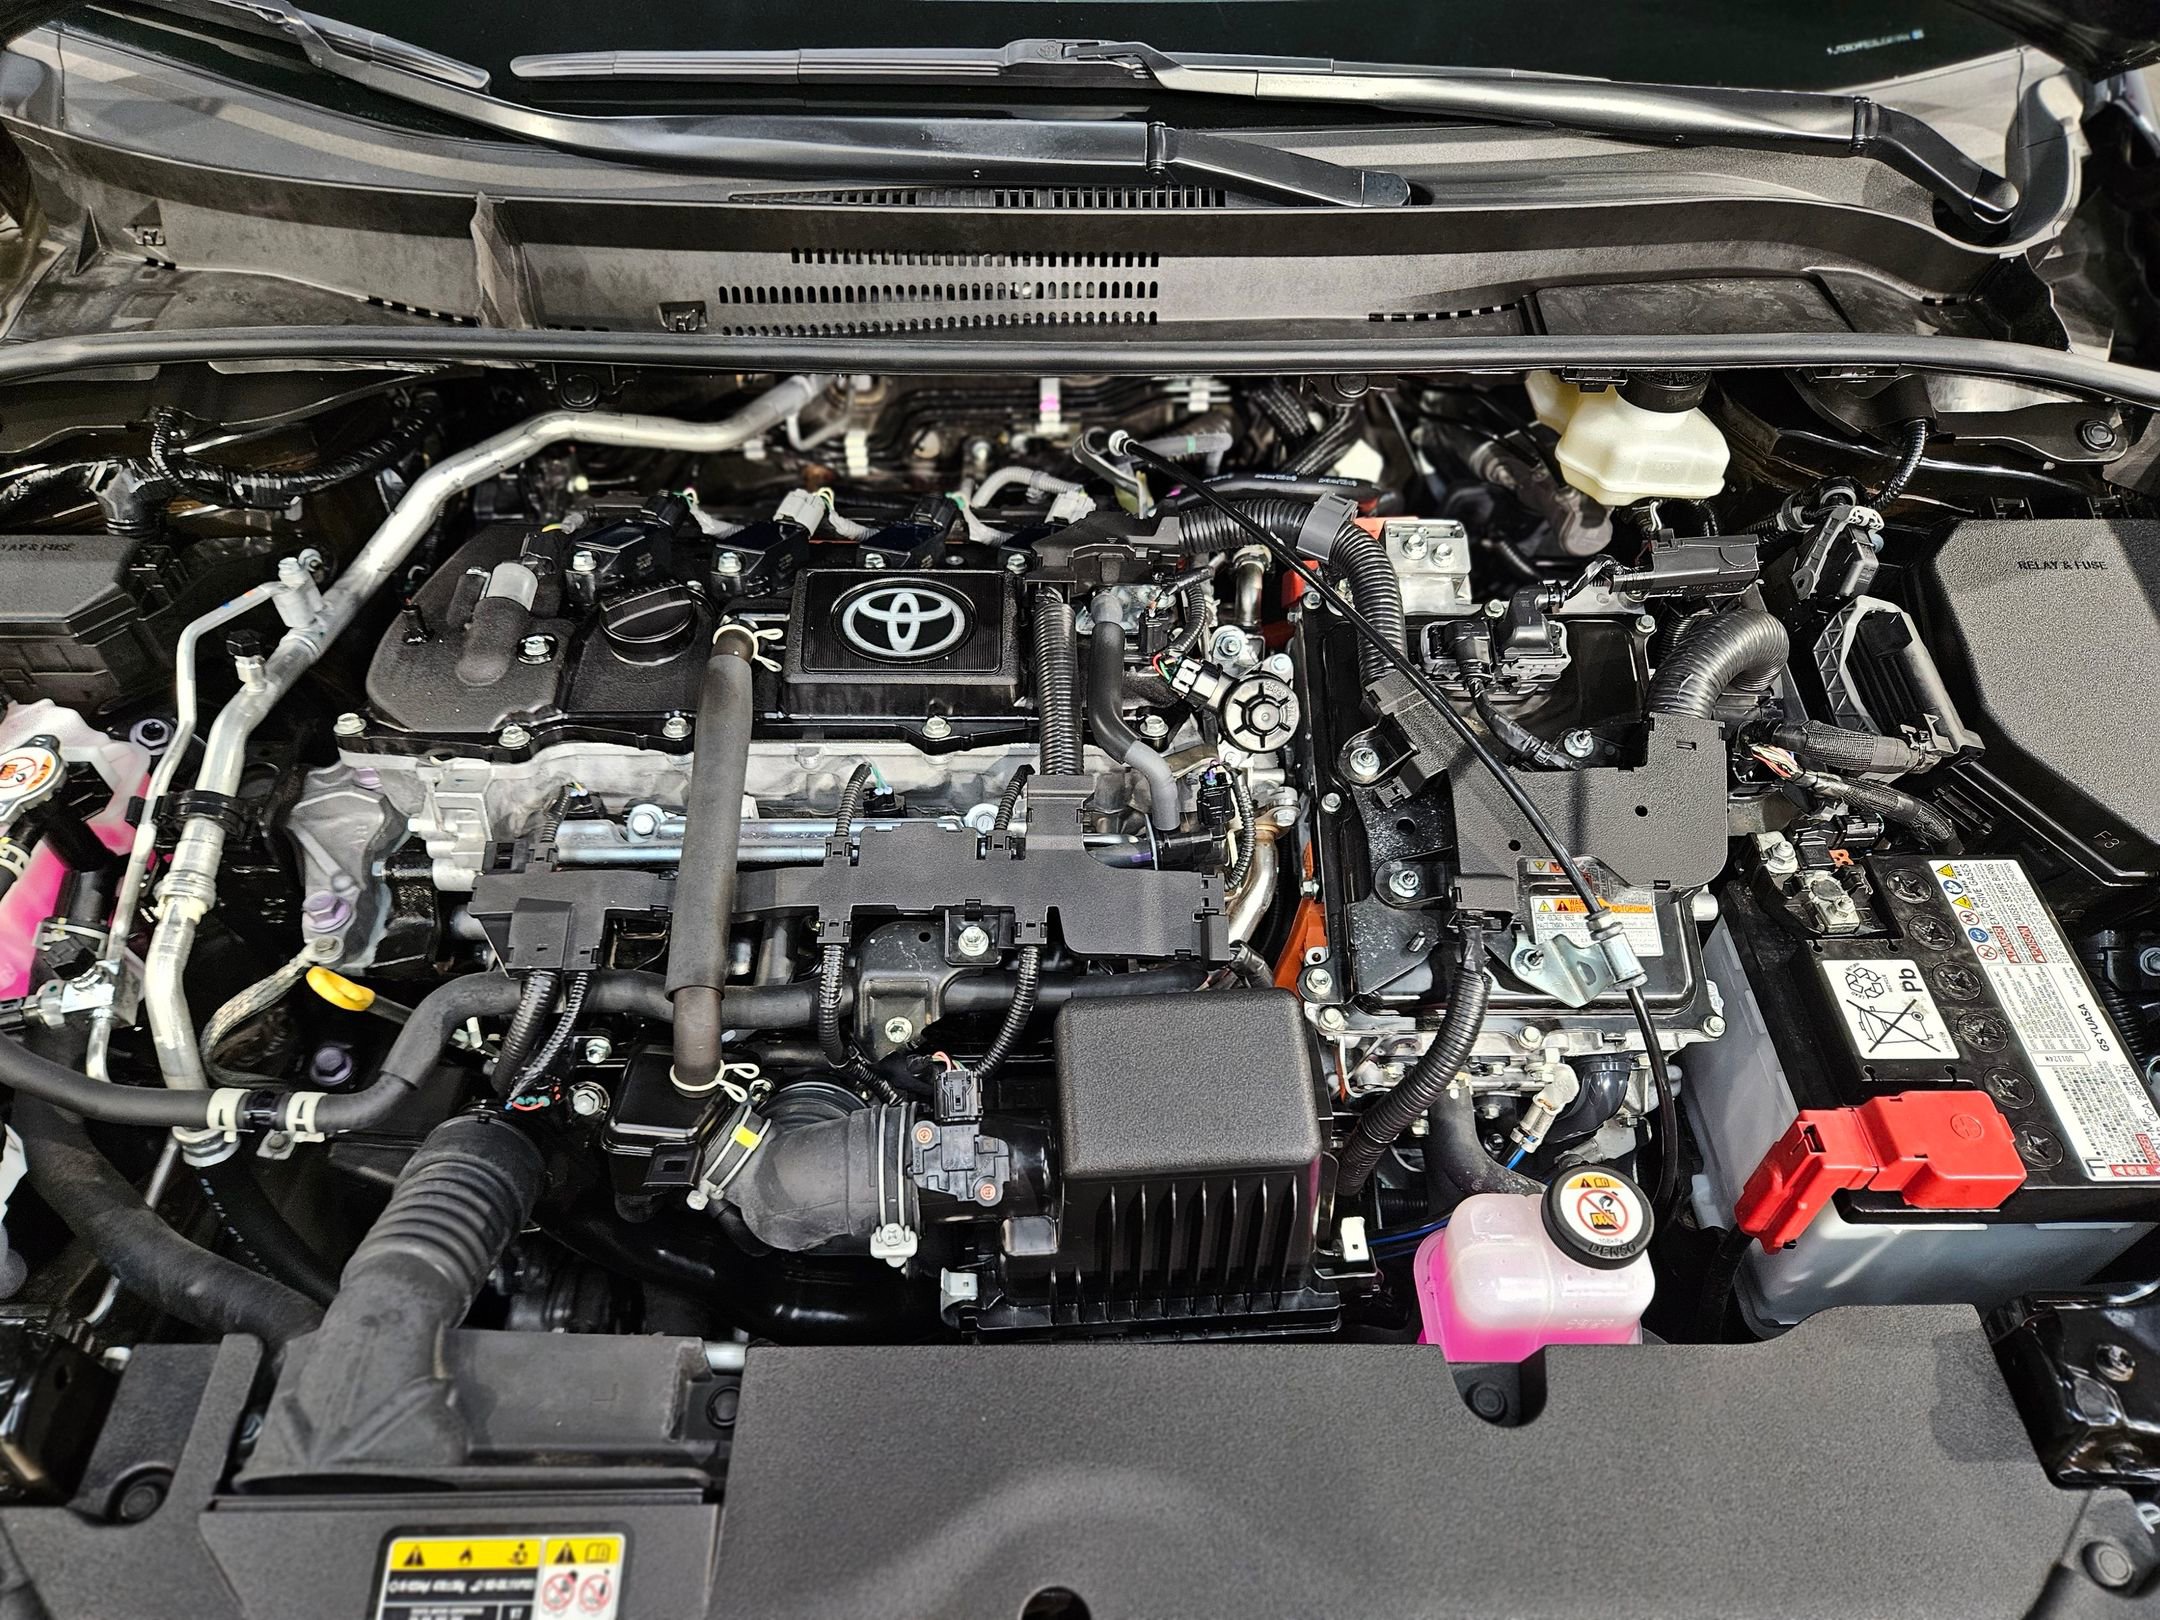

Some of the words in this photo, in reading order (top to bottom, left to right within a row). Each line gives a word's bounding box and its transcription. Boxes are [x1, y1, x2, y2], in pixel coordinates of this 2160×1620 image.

[2017, 560, 2058, 570] RELAY
[2062, 560, 2073, 570] &
[2075, 560, 2108, 570] FUSE
[1264, 681, 1287, 697] 25620
[2094, 830, 2120, 849] F3
[1960, 863, 1978, 886] GASES
[1984, 863, 2001, 882] BURNS
[1994, 882, 2013, 903] SEVERE
[1972, 888, 2000, 925] EXPLOSIVE
[2007, 903, 2025, 925] CAUSES
[1996, 927, 2016, 956] DANGER
[2020, 927, 2043, 956] POISON
[1899, 968, 1923, 992] Pb
[2078, 1003, 2102, 1037] YUASA
[2097, 1038, 2110, 1052] GS
[1588, 1242, 1636, 1257] DENSO
